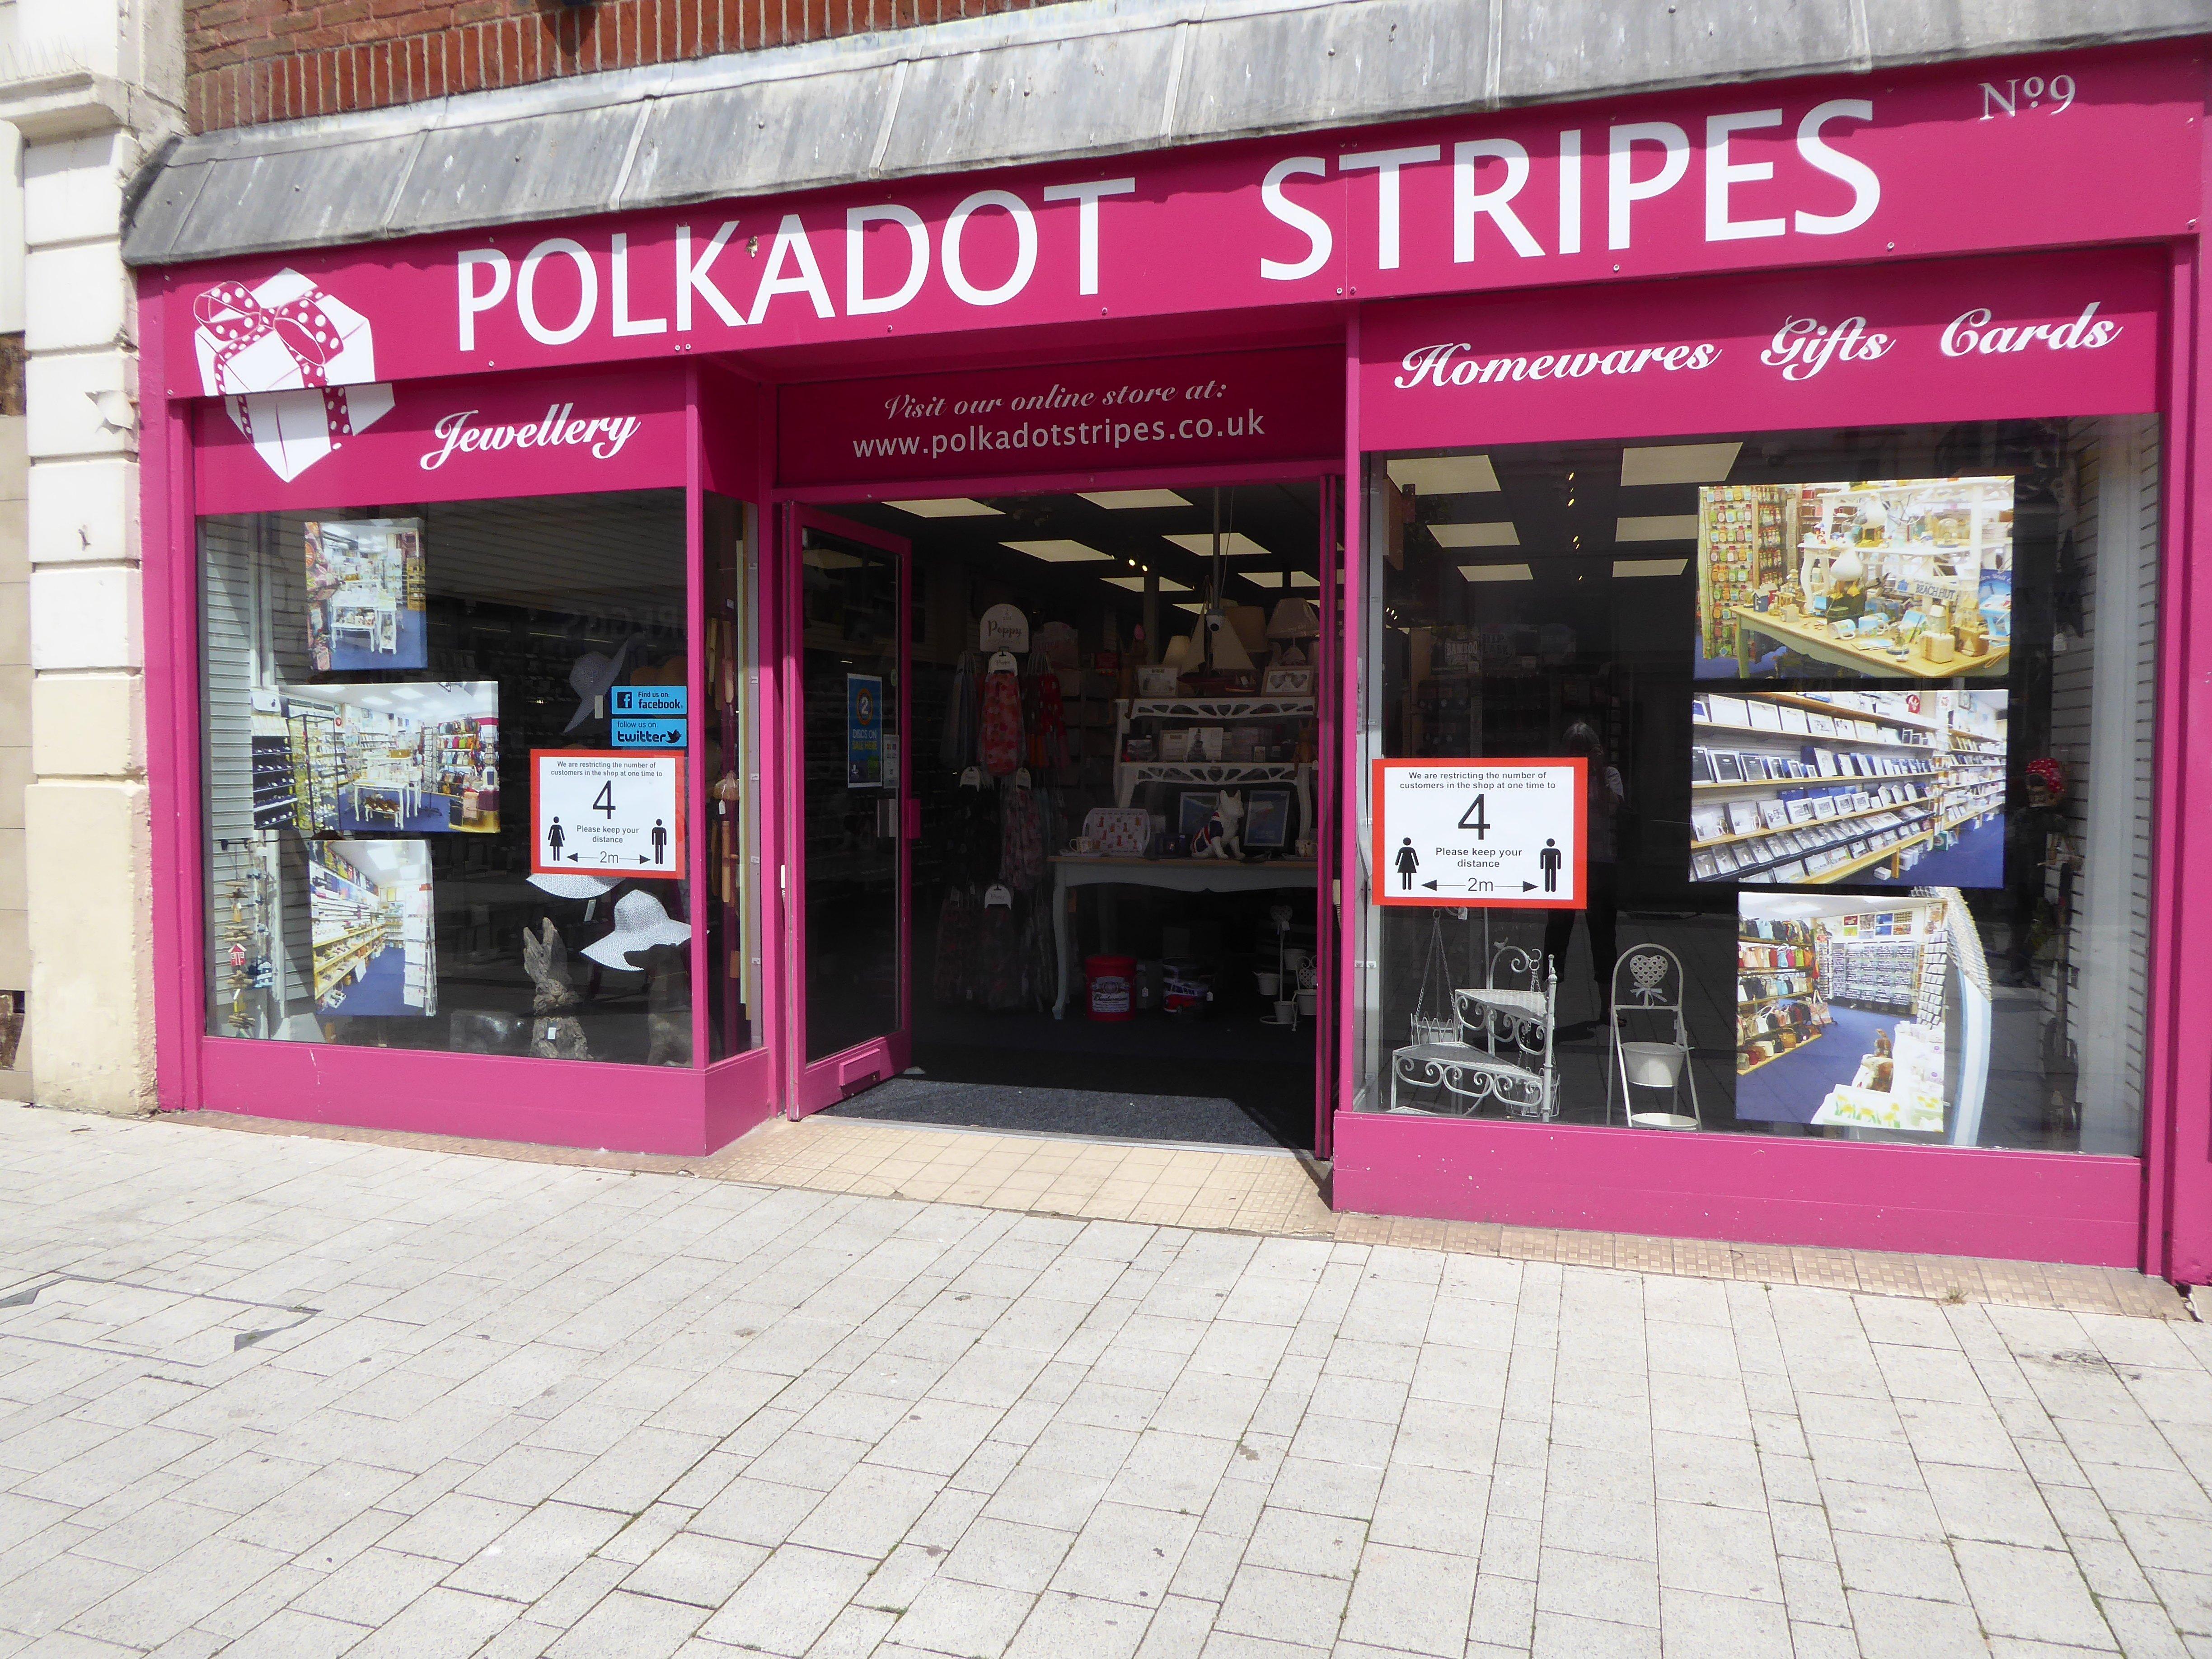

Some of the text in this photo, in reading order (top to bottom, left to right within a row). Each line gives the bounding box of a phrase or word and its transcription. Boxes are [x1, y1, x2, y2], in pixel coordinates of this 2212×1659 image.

[457, 98, 1881, 351] POLKADOT STRIPES
[1940, 302, 2124, 357] Cards
[1760, 315, 1896, 381] Gifts
[1394, 343, 1722, 389] Homewares
[885, 380, 1227, 419] Visit our online store at:
[420, 403, 641, 470] Jewellery
[853, 408, 1265, 459] www.polkadotstripes.co.uk
[988, 620, 1022, 638] Poppy
[1447, 641, 1478, 656] BAMBOO
[860, 697, 869, 714] 2
[618, 731, 666, 742] twitter
[852, 728, 877, 740] DISCS ON
[1440, 772, 1483, 780] restricting
[1473, 782, 1494, 790] shop
[593, 780, 616, 820] 4
[1458, 794, 1490, 840] 4
[603, 826, 620, 834] keep
[600, 851, 619, 863] 2m
[1472, 848, 1496, 858] keep
[1499, 849, 1522, 858] your
[1457, 859, 1500, 867] distance
[1468, 877, 1493, 892] 2m
